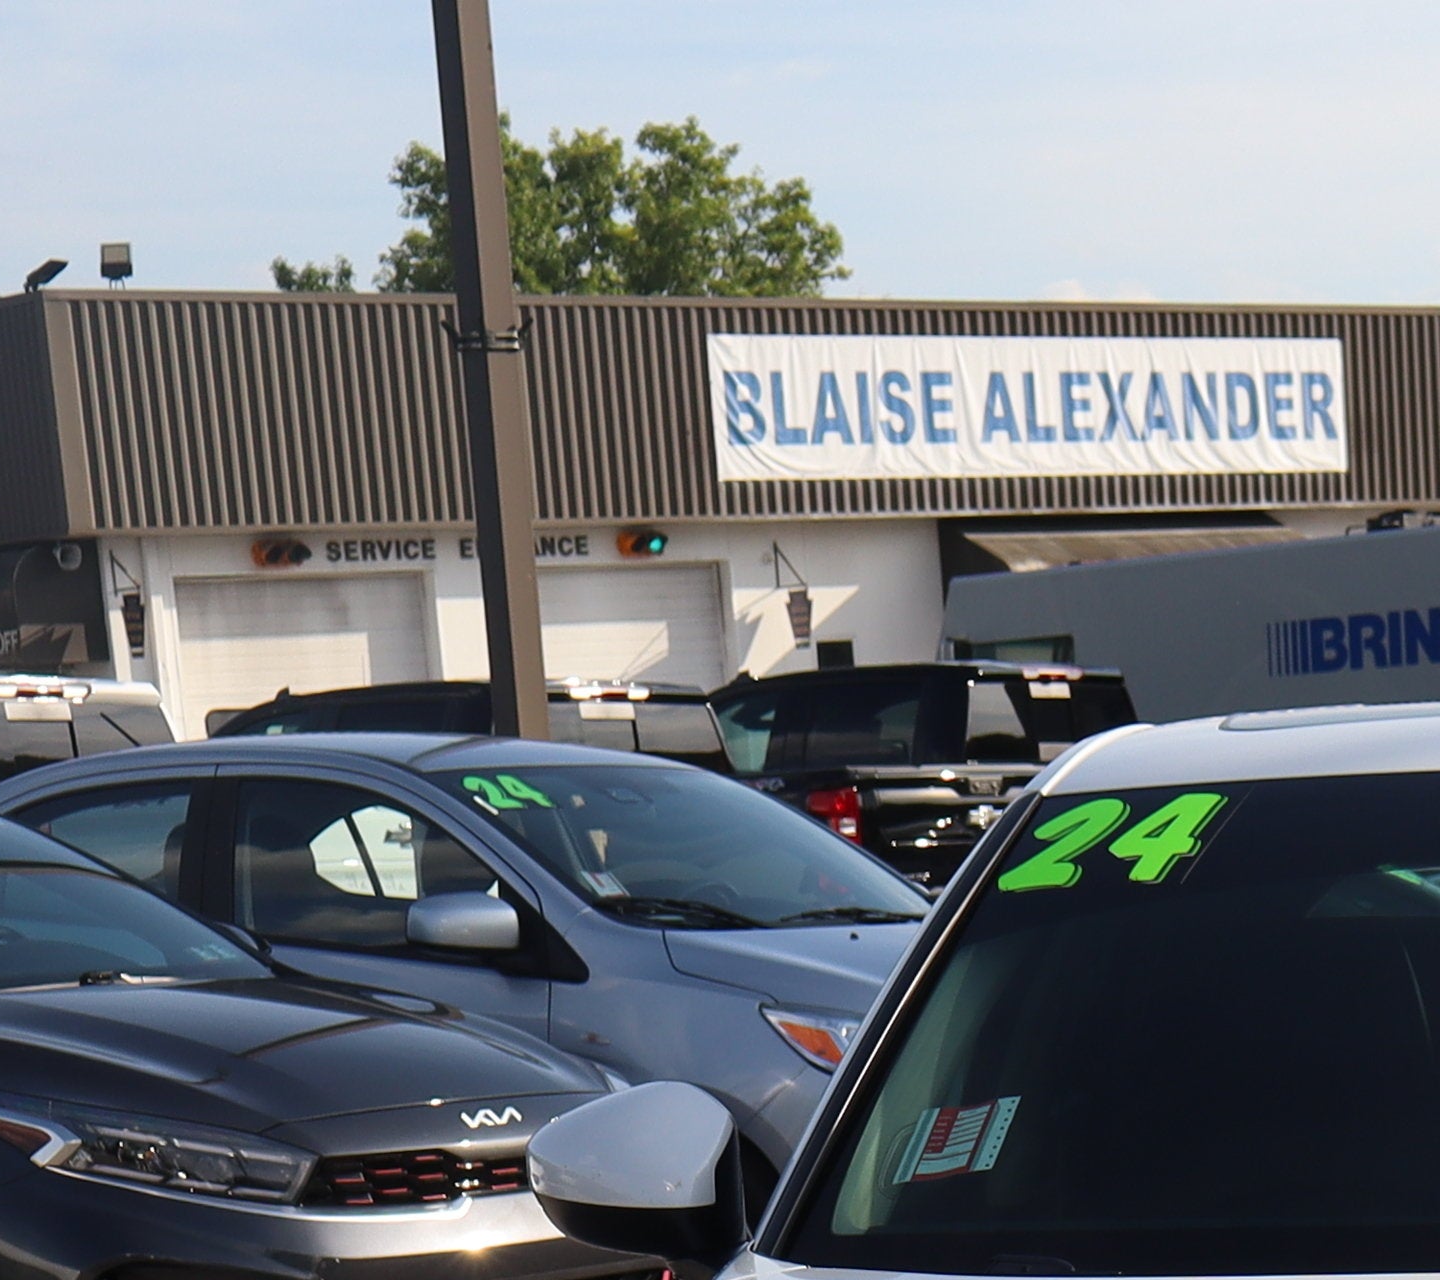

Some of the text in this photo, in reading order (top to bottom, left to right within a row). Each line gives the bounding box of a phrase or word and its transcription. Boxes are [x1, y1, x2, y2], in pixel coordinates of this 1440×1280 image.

[722, 371, 1339, 446] BLAISE ALEXANDER
[326, 538, 436, 562] SERVICE
[462, 774, 553, 809] 24
[998, 793, 1228, 892] 24
